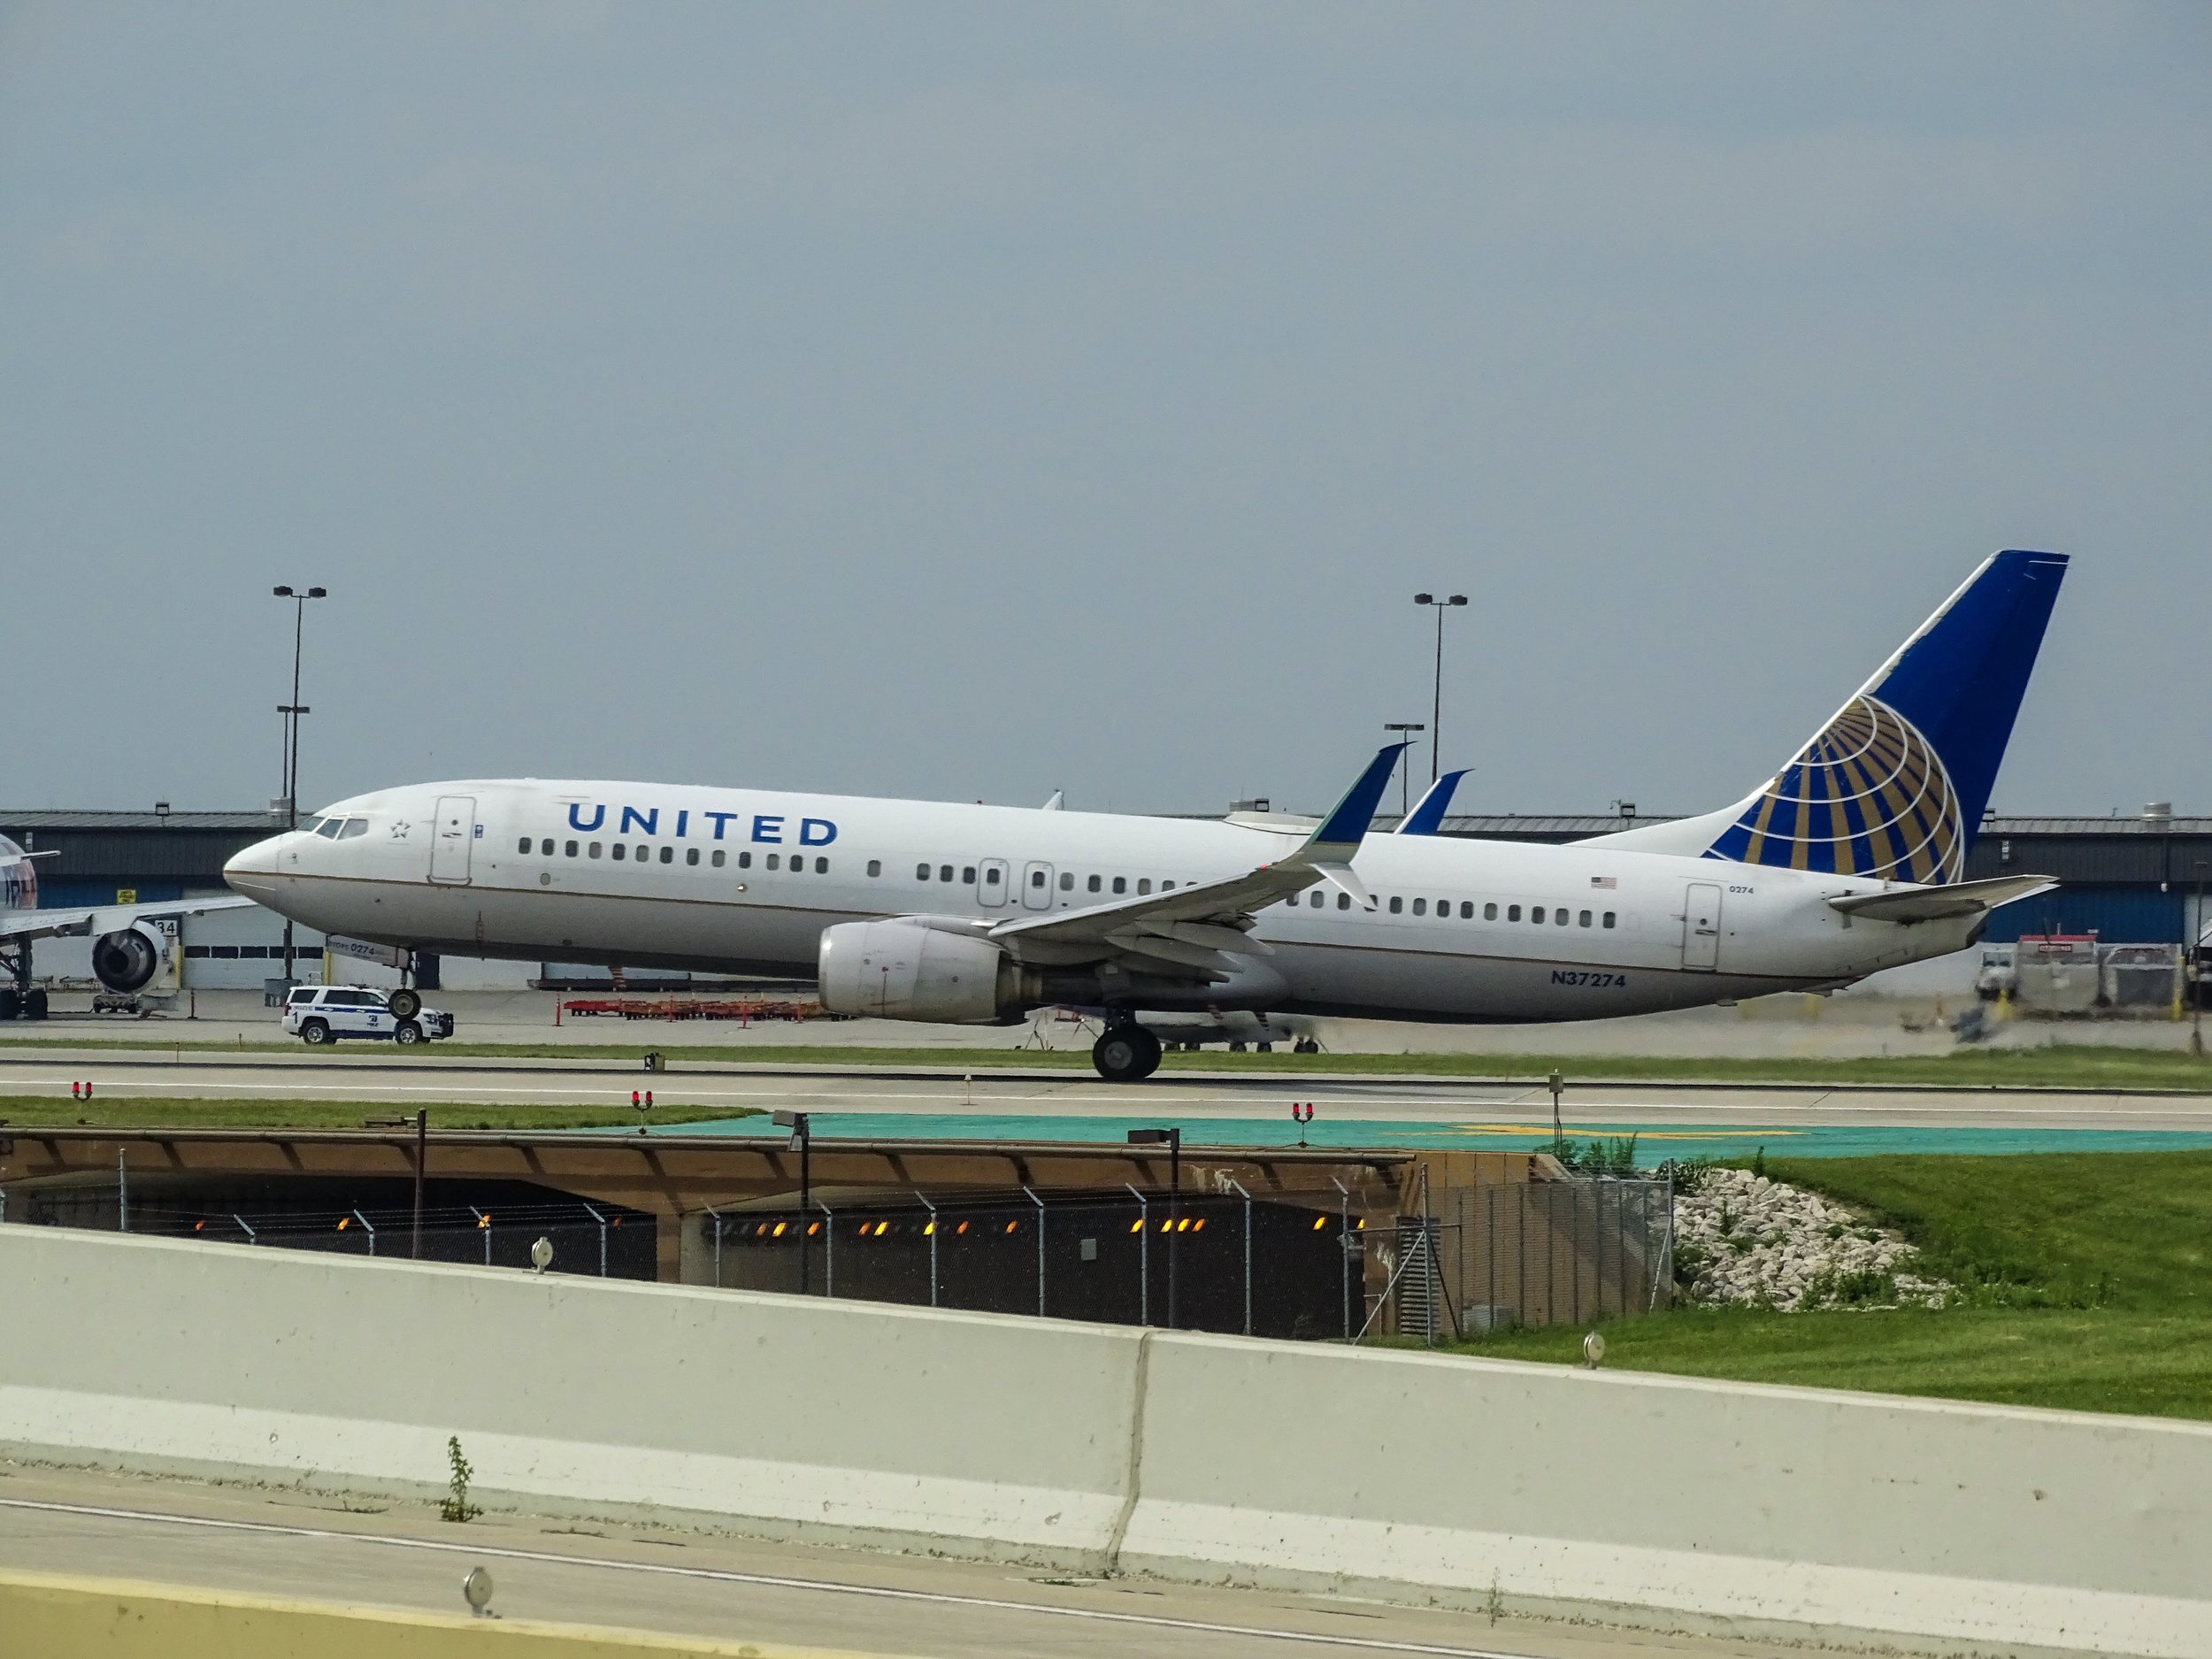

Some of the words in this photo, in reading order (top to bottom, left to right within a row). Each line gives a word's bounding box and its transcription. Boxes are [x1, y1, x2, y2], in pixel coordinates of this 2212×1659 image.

[569, 803, 838, 847] UNITED
[157, 922, 175, 933] 34
[350, 943, 375, 956] 0274
[1551, 971, 1626, 987] N37274
[292, 1011, 297, 1024] 1
